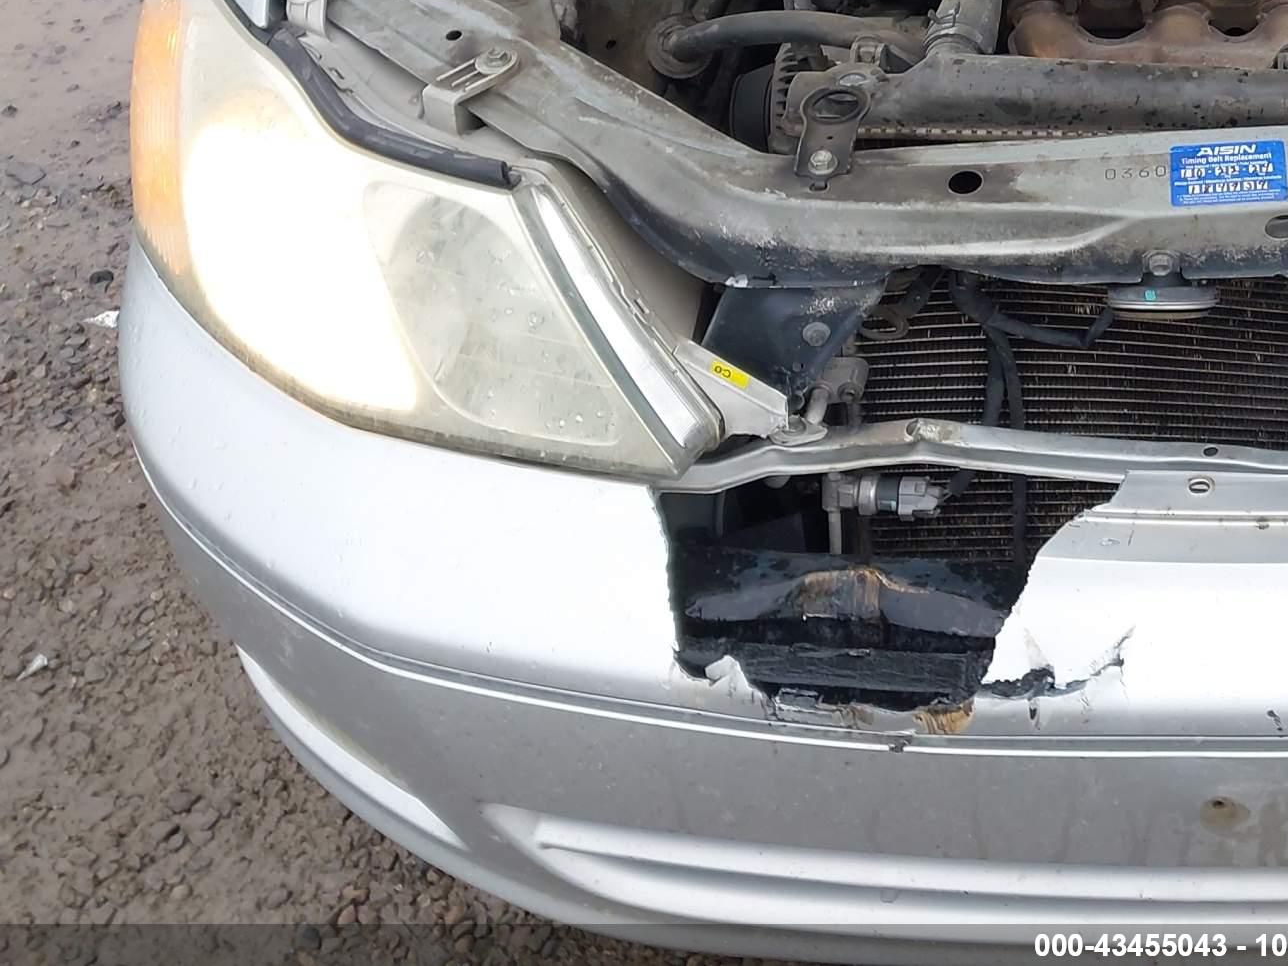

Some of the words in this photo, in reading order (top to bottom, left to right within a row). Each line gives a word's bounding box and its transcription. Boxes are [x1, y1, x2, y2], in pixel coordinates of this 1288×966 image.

[1196, 144, 1257, 157] AISIN
[1182, 157, 1207, 165] Timing
[1208, 155, 1224, 163] Belt
[1225, 152, 1272, 163] Replacement
